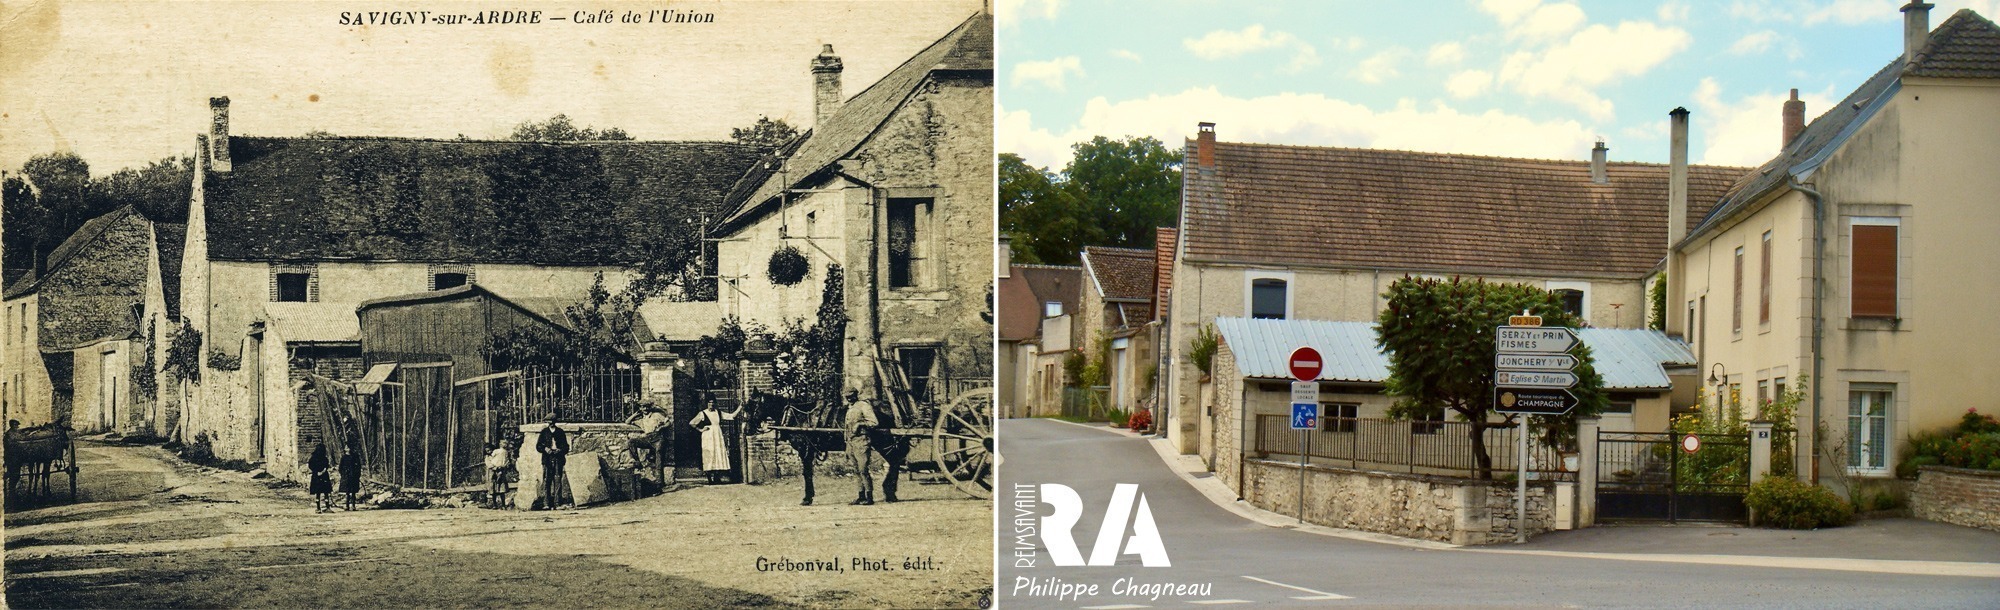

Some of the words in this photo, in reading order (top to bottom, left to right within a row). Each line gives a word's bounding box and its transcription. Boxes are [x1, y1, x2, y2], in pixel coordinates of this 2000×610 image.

[1524, 317, 1541, 326] 386
[1502, 331, 1532, 339] SERZY
[1542, 331, 1564, 340] PRIN
[1501, 340, 1537, 349] FISMES
[1500, 357, 1547, 367] JONCHERY
[1510, 374, 1532, 385] Eglise
[1541, 375, 1567, 384] Martin
